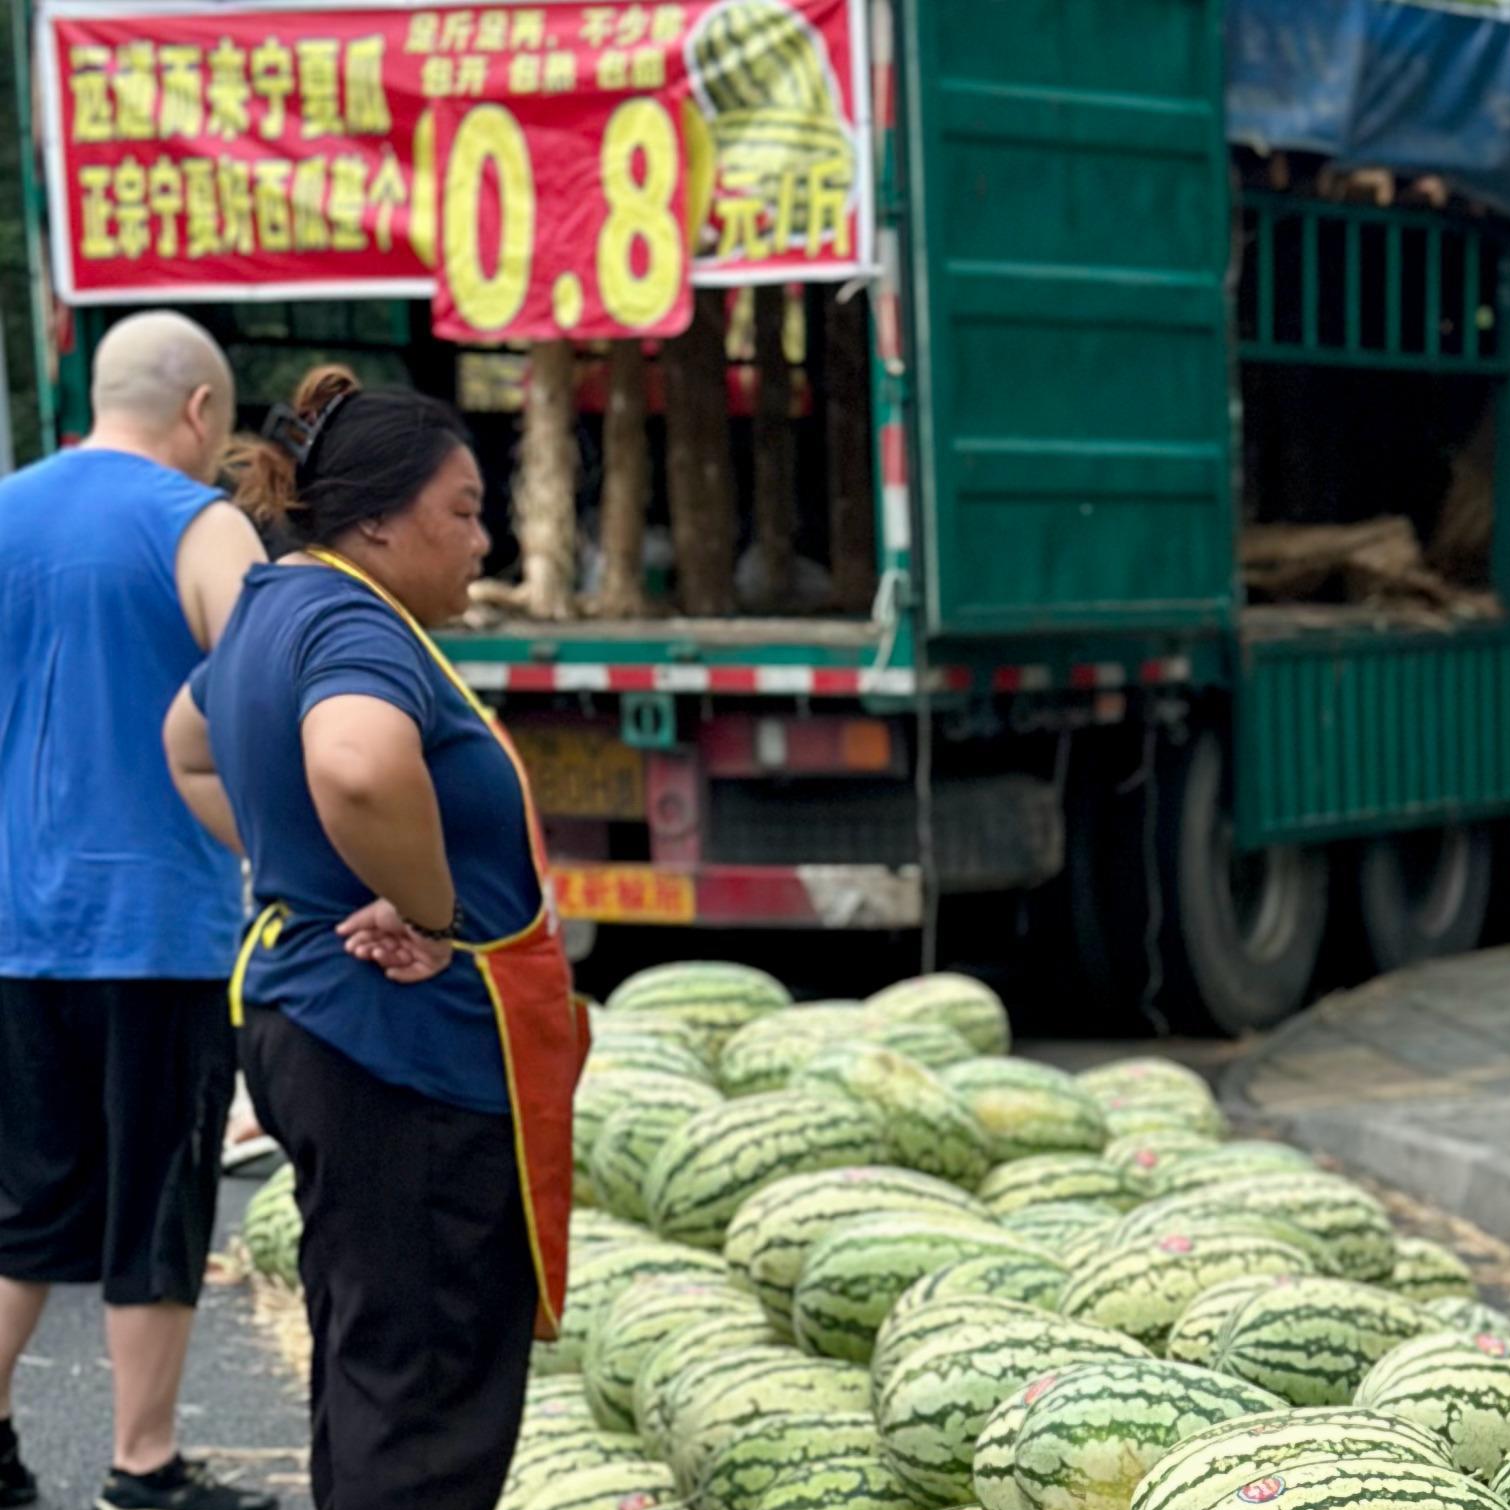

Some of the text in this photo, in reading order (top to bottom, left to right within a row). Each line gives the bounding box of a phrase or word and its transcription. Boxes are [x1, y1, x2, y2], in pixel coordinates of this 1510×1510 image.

[70, 34, 393, 143] 远道而来宁夏瓜
[444, 97, 682, 332] 0.8
